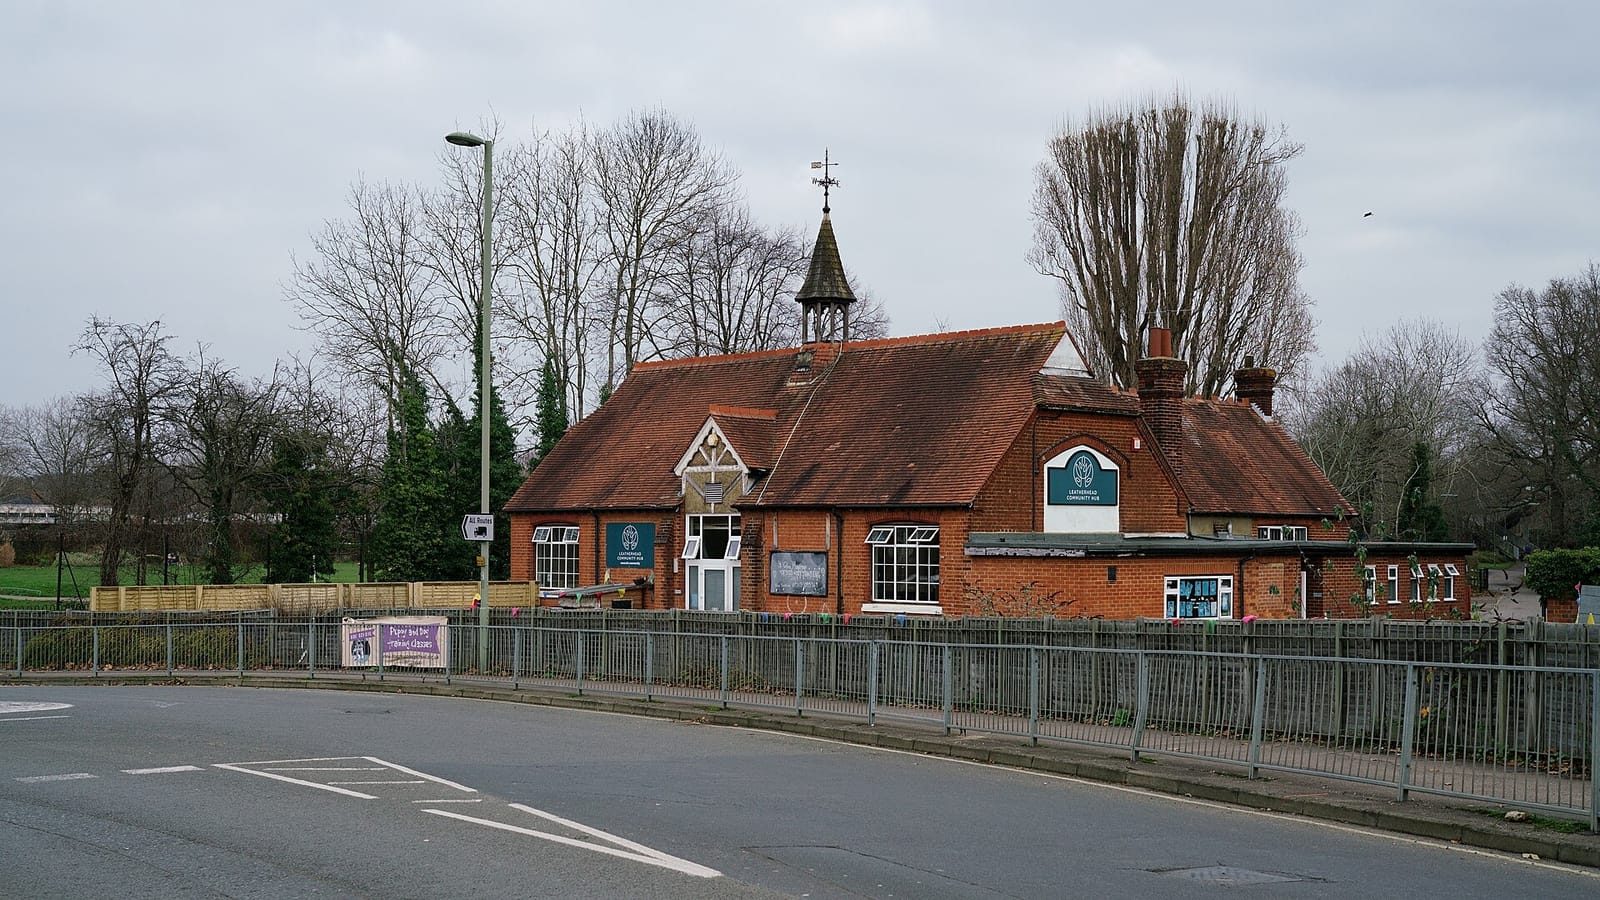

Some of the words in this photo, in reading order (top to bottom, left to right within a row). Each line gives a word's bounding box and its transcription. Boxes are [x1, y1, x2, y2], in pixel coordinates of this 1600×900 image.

[390, 626, 407, 638] Puppy
[408, 628, 418, 636] and
[419, 627, 429, 638] Dog
[410, 638, 432, 648] classes
